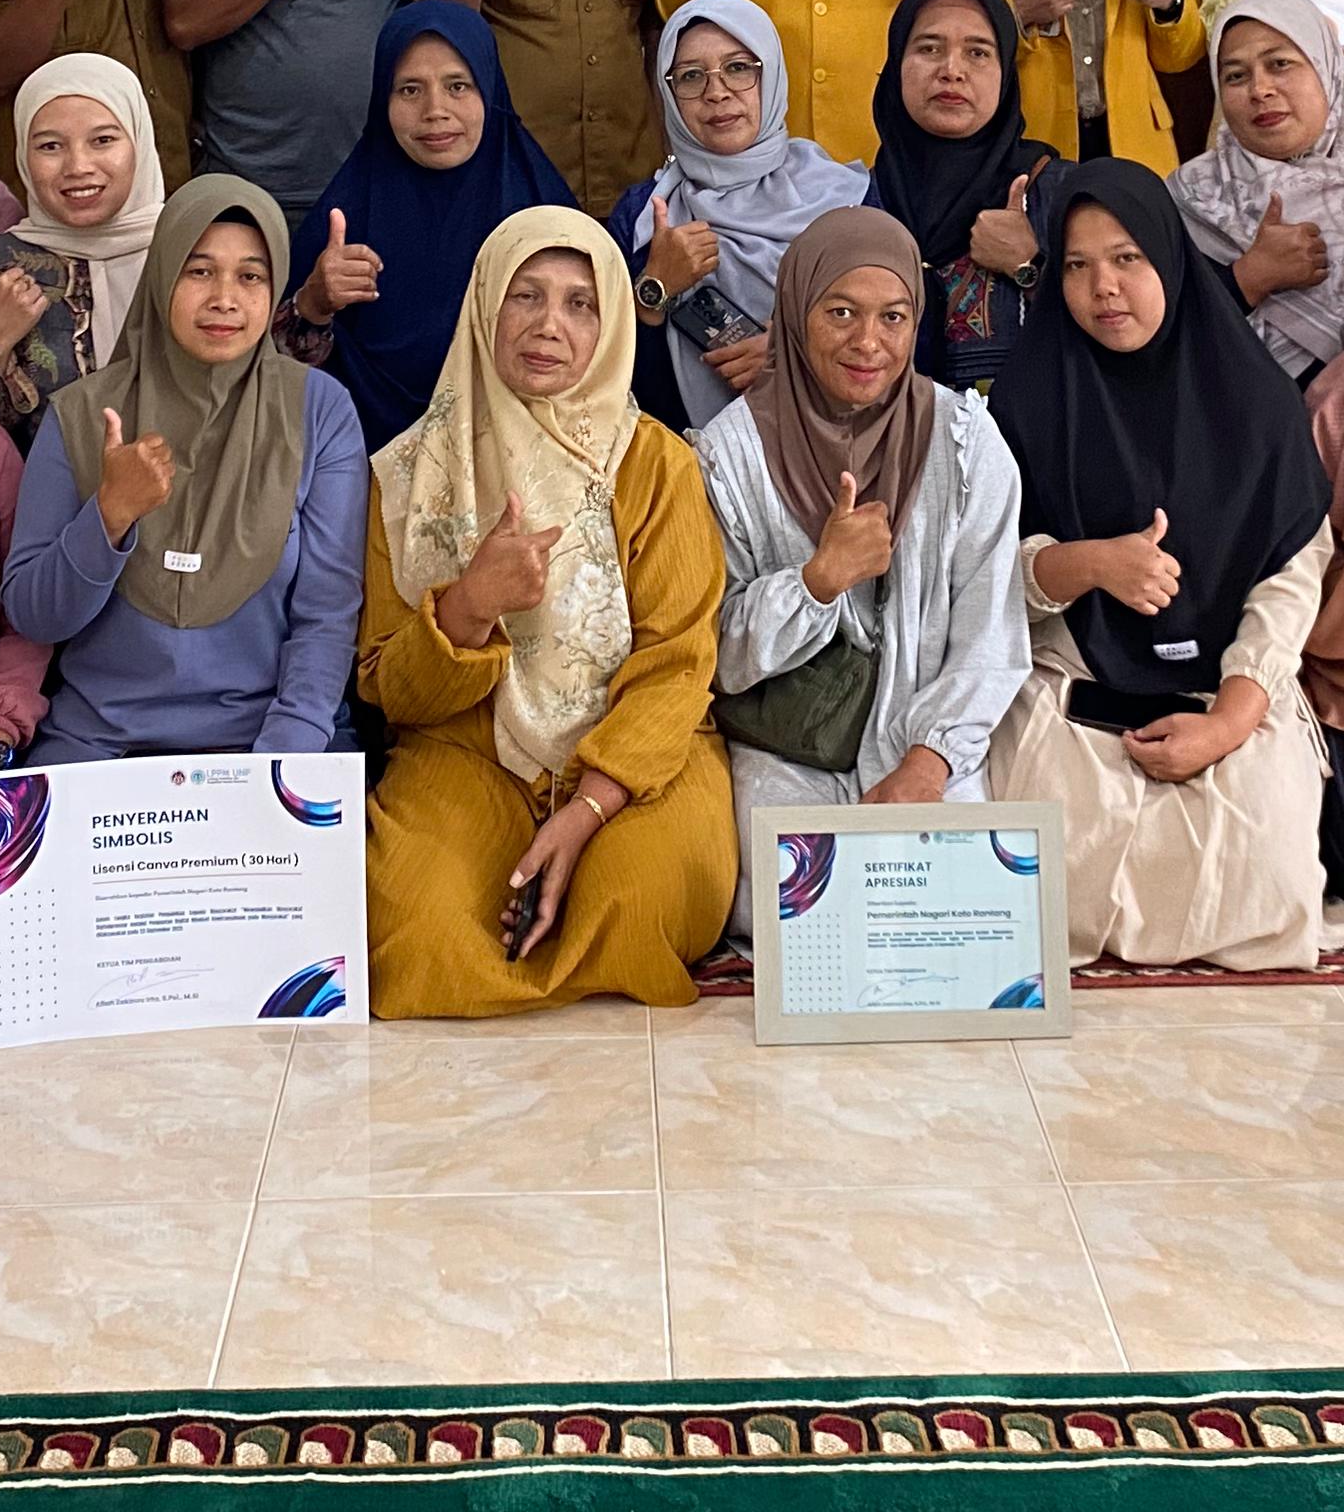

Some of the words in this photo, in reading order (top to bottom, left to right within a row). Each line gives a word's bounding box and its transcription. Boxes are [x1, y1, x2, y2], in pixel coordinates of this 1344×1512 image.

[92, 808, 209, 828] PENYERAHAN
[92, 831, 173, 849] SIMBOLIS
[92, 860, 135, 875] Lisensi
[138, 860, 178, 870] Canva
[181, 854, 238, 868] Premium
[249, 854, 264, 865] 30
[266, 854, 291, 865] Hari
[864, 862, 932, 873] SERTIFIKAT
[865, 877, 927, 888] APRESIASI
